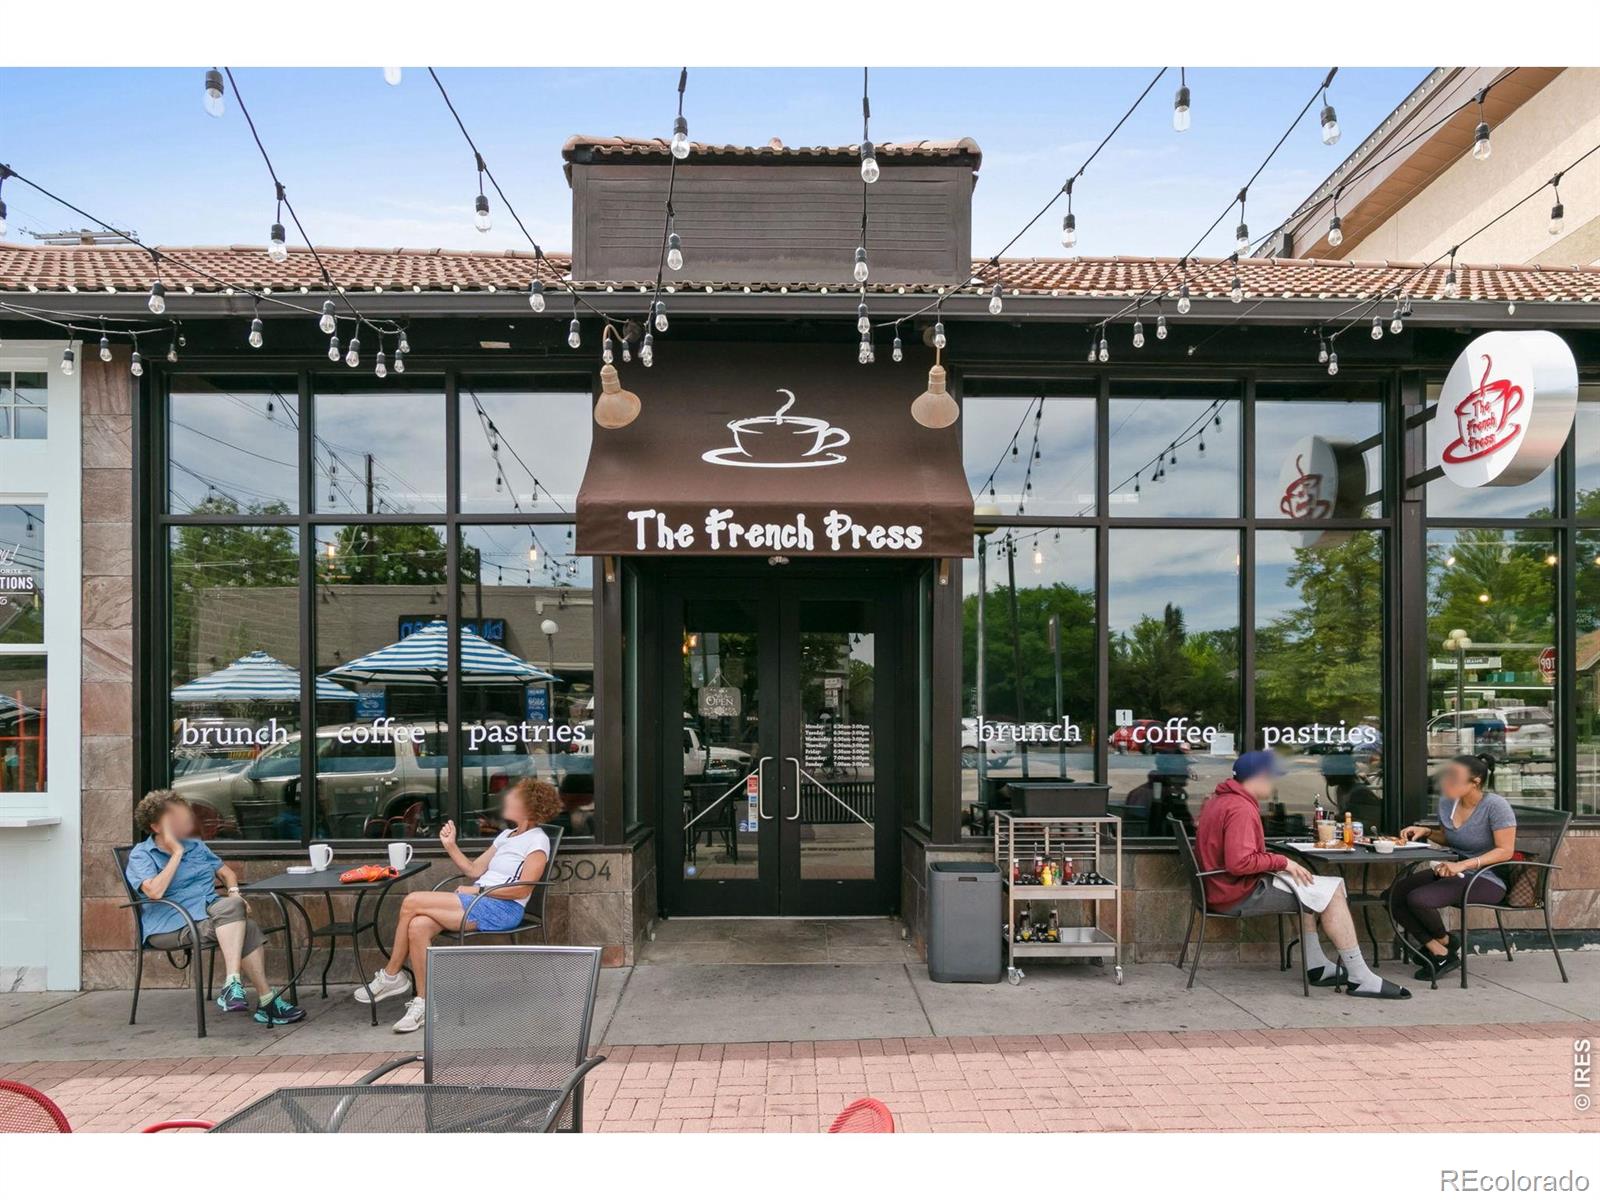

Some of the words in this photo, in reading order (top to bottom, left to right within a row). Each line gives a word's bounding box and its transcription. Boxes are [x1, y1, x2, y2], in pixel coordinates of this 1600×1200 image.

[1472, 401, 1491, 418] The
[1467, 412, 1496, 435] French
[1468, 433, 1496, 453] Press
[627, 508, 695, 551] The
[705, 508, 815, 551] French
[823, 509, 923, 551] Press
[181, 717, 290, 745] brunch
[337, 717, 426, 744] coffee
[468, 718, 587, 750] pastries
[976, 715, 1082, 743] brunch
[1132, 717, 1217, 744] coffee
[1262, 719, 1377, 751] pastries
